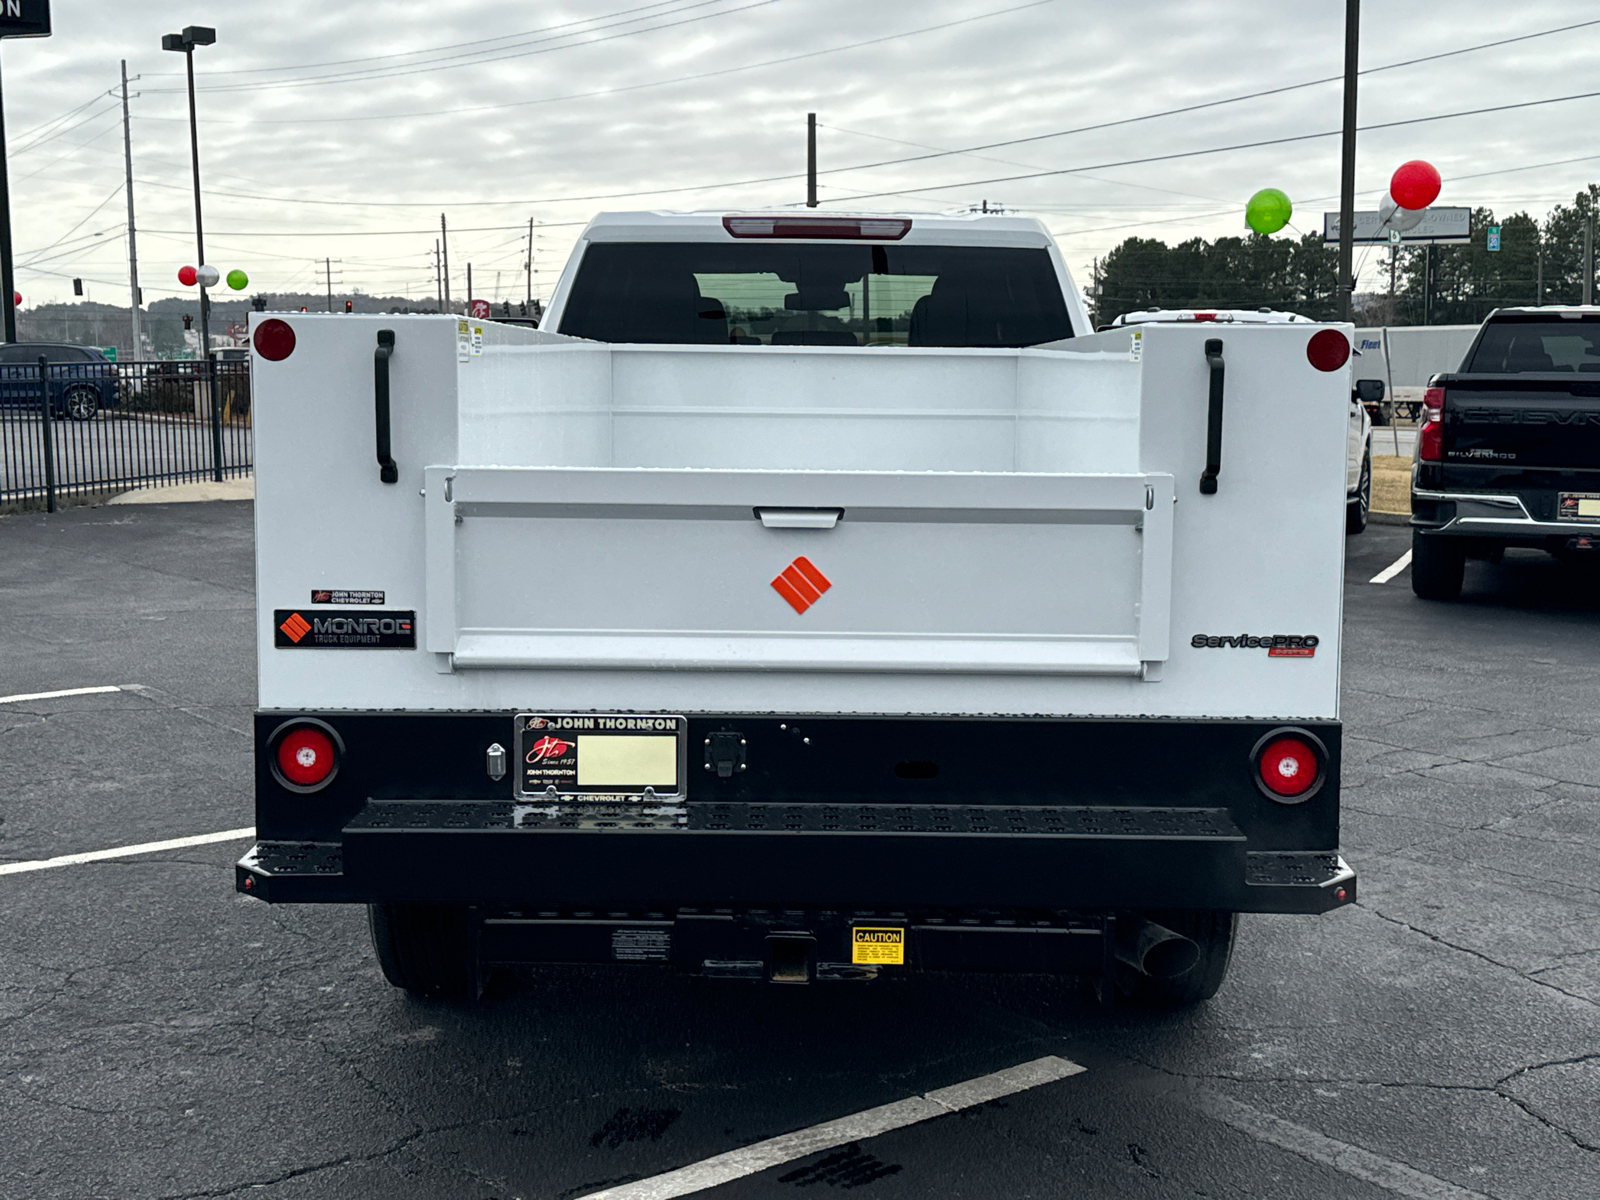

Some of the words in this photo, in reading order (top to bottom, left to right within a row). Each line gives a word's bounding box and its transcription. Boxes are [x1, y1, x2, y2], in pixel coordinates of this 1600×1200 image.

[1489, 238, 1498, 247] 20
[313, 617, 411, 635] MONROE
[315, 635, 338, 643] TRUCK
[340, 635, 380, 644] EQUIPMENT
[555, 717, 594, 729] JOHN
[597, 717, 676, 730] THORNTON
[856, 932, 900, 942] CAUTION
